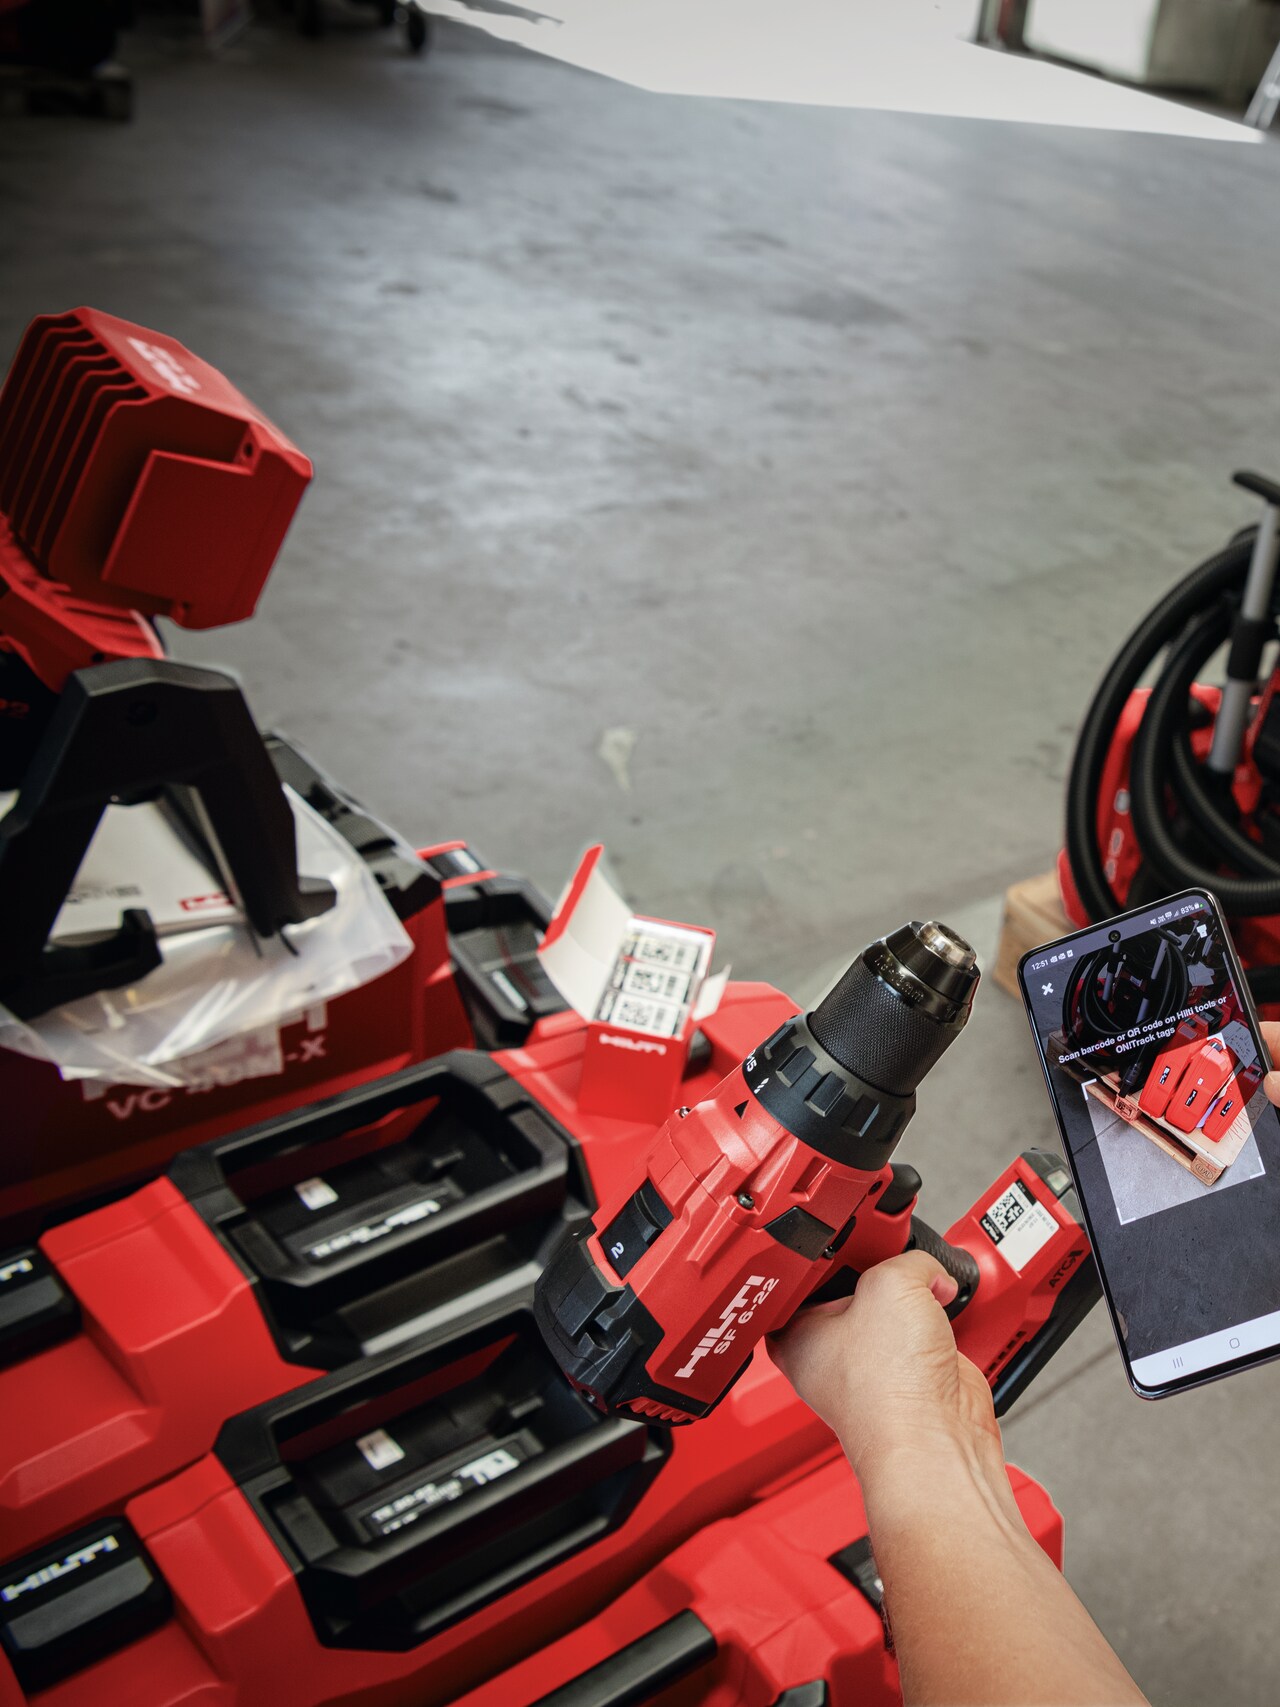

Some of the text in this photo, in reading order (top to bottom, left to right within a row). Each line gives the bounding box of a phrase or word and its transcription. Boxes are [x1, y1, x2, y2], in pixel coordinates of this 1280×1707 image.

[1180, 904, 1195, 915] 83%
[1031, 959, 1049, 971] 12:51
[1058, 996, 1227, 1064] Scan barcode or QR code on Hilti tools or
[1115, 1026, 1176, 1054] ON!Track tags
[106, 1087, 172, 1120] VC
[611, 1241, 624, 1259] 2
[674, 1275, 766, 1378] HILTI
[713, 1278, 780, 1355] SF 6-22
[0, 1535, 119, 1602] HILTI
